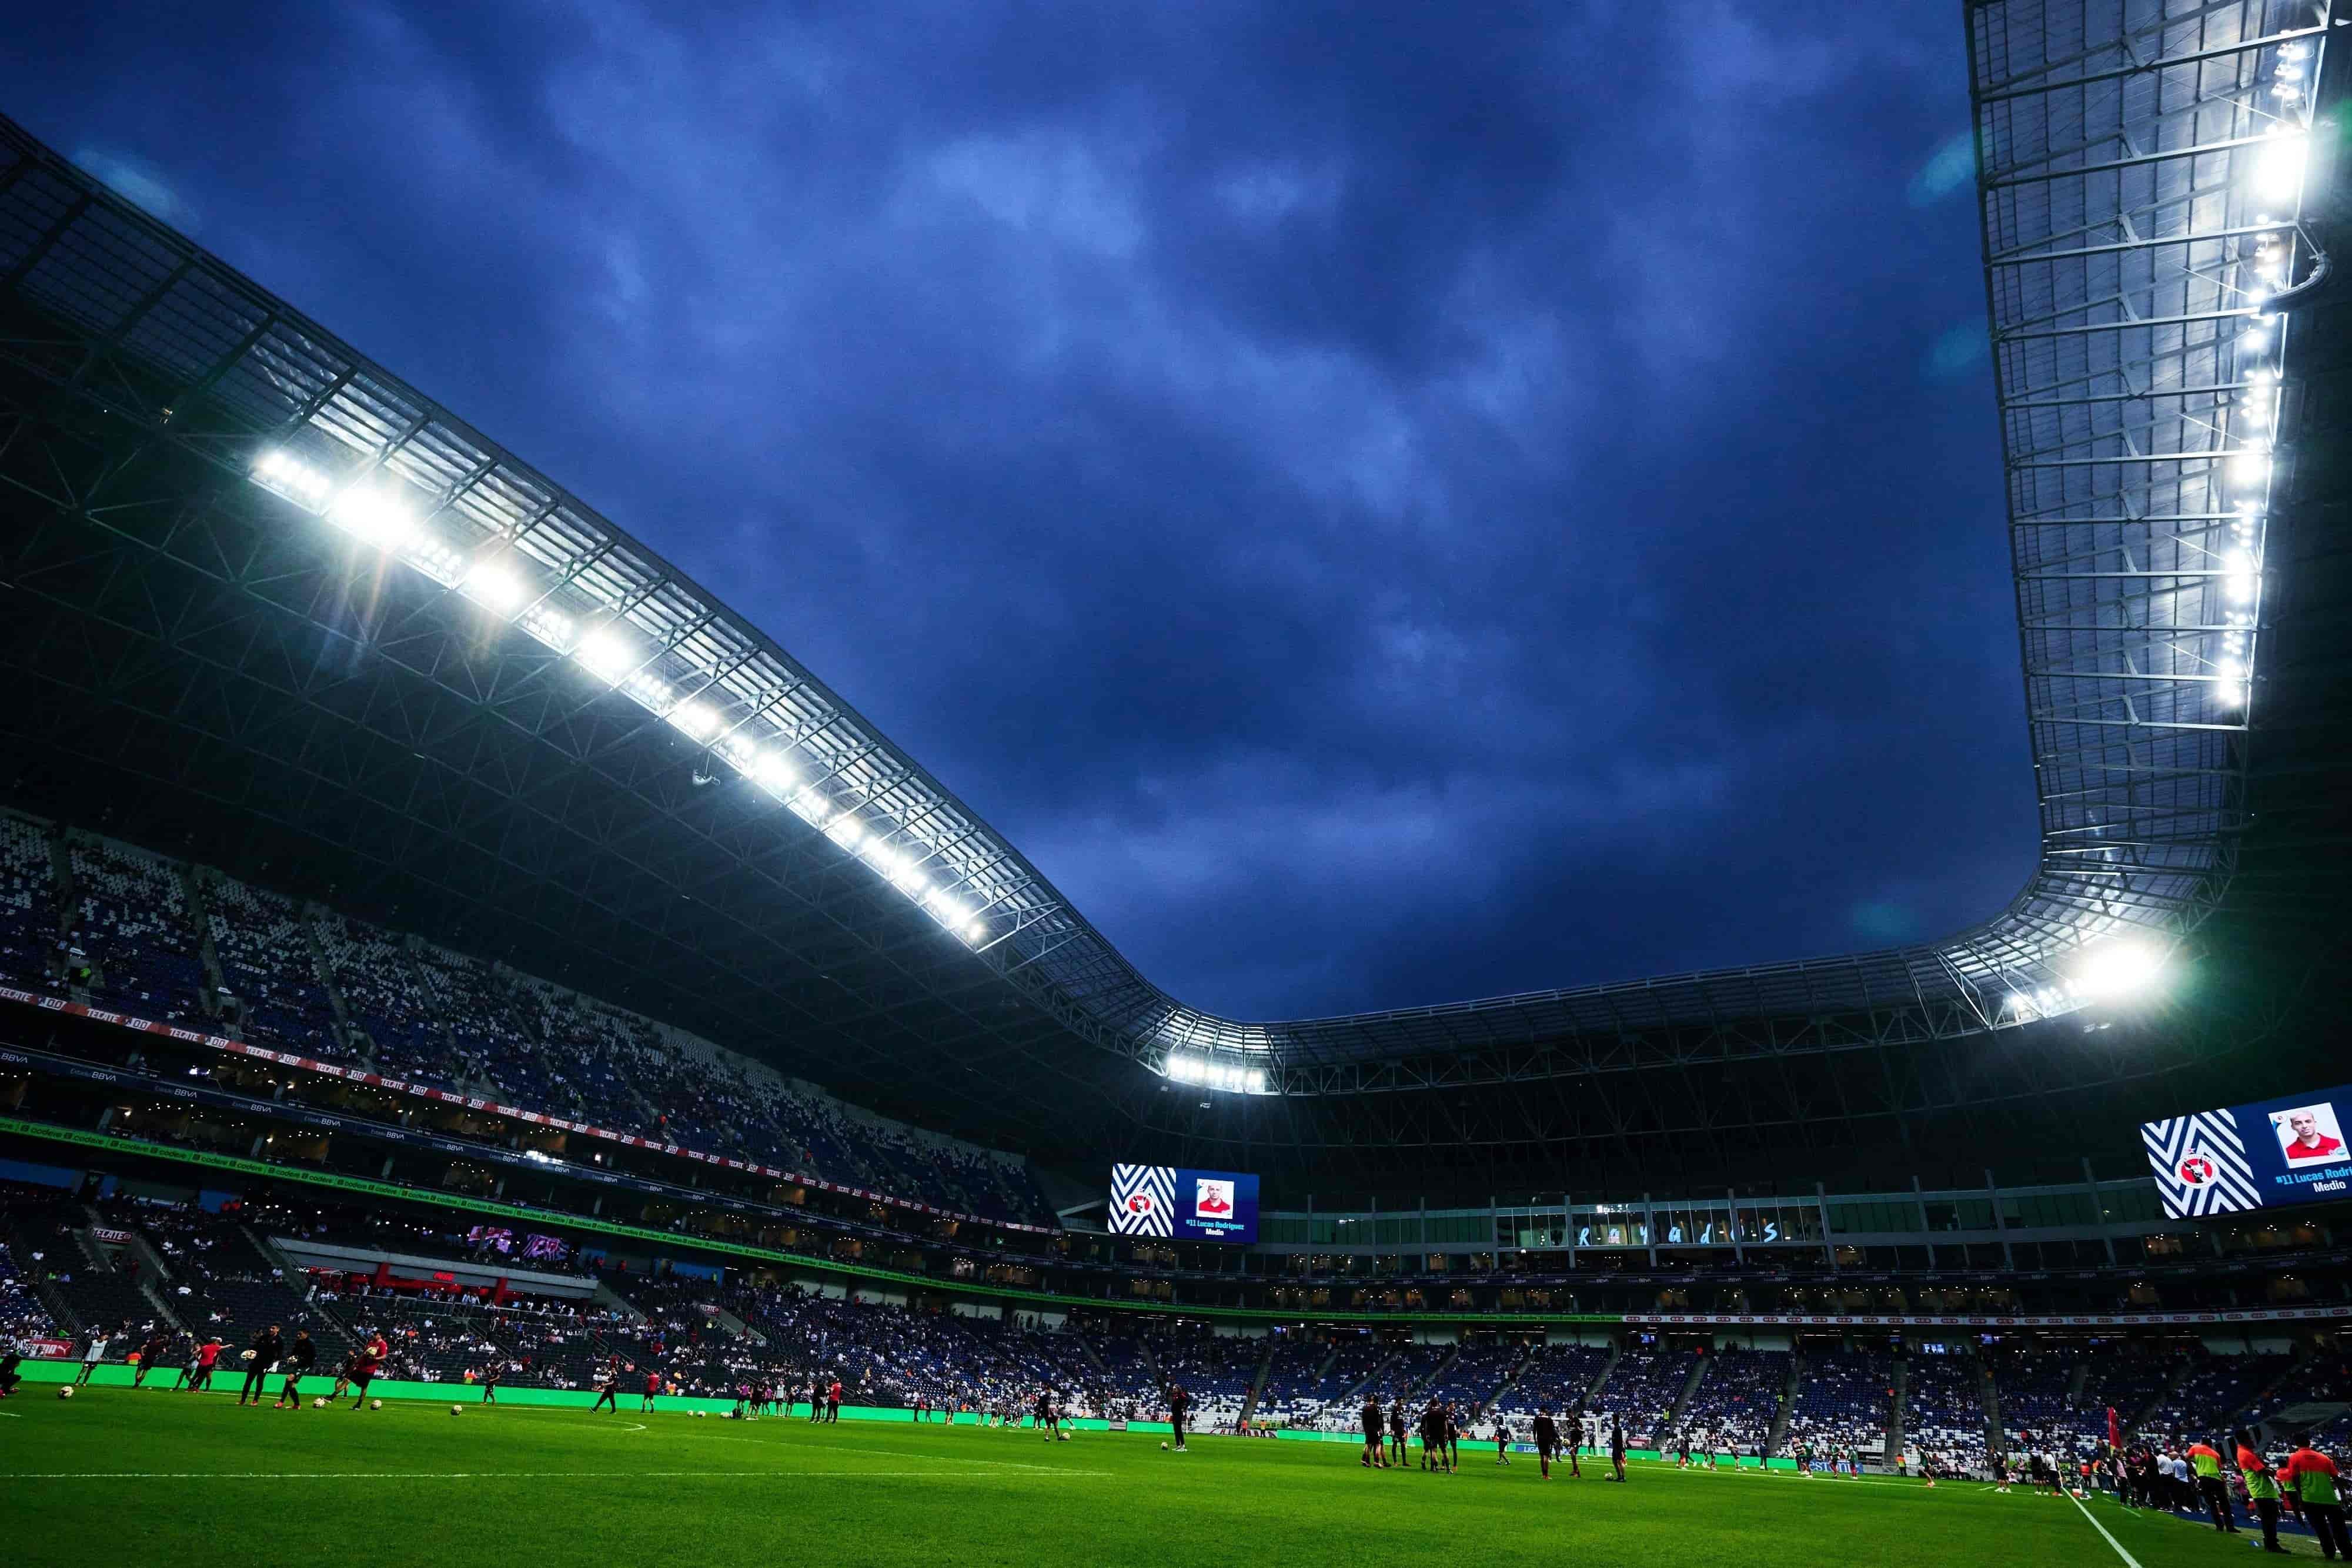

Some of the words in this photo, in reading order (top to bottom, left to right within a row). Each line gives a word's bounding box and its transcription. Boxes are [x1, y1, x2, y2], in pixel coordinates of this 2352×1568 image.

[86, 1008, 119, 1023] TECATE
[169, 1028, 200, 1042] TECATE
[246, 1046, 274, 1059] TECATE
[1, 1052, 29, 1064] BBVA
[316, 1062, 342, 1076] TECATE
[91, 1071, 116, 1082] BBVA
[381, 1078, 405, 1091] TECATE
[174, 1088, 197, 1098] BBVA
[441, 1092, 463, 1104] TECATE
[250, 1104, 272, 1114] BBVA
[498, 1105, 518, 1116] TECATE
[321, 1118, 341, 1127] BBVA
[550, 1119, 569, 1129] TECATE
[31, 1125, 61, 1138] codere
[386, 1131, 405, 1141] BBVA
[599, 1129, 617, 1139] TECATE
[74, 1133, 104, 1145] codere
[120, 1142, 148, 1152] codere
[446, 1144, 464, 1152] BBVA
[645, 1141, 663, 1151] TECATE
[159, 1149, 186, 1159] codere
[688, 1151, 704, 1160] TECATE
[201, 1155, 230, 1166] codere
[729, 1161, 744, 1169] TECATE
[237, 1162, 263, 1172] codere
[555, 1165, 570, 1174] BBVA
[276, 1168, 300, 1178] codere
[309, 1175, 333, 1183] codere
[2275, 1174, 2294, 1185] #11
[2294, 1172, 2324, 1183] Lucas
[345, 1181, 367, 1190] codere
[2312, 1180, 2347, 1193] Medio
[376, 1187, 397, 1195] codere
[408, 1192, 430, 1202] codere
[437, 1197, 457, 1206] codere
[467, 1202, 486, 1210] codere
[495, 1206, 513, 1214] codere
[1186, 1219, 1196, 1227] #11
[93, 1227, 123, 1240] TECATE
[1205, 1228, 1224, 1236] Medio
